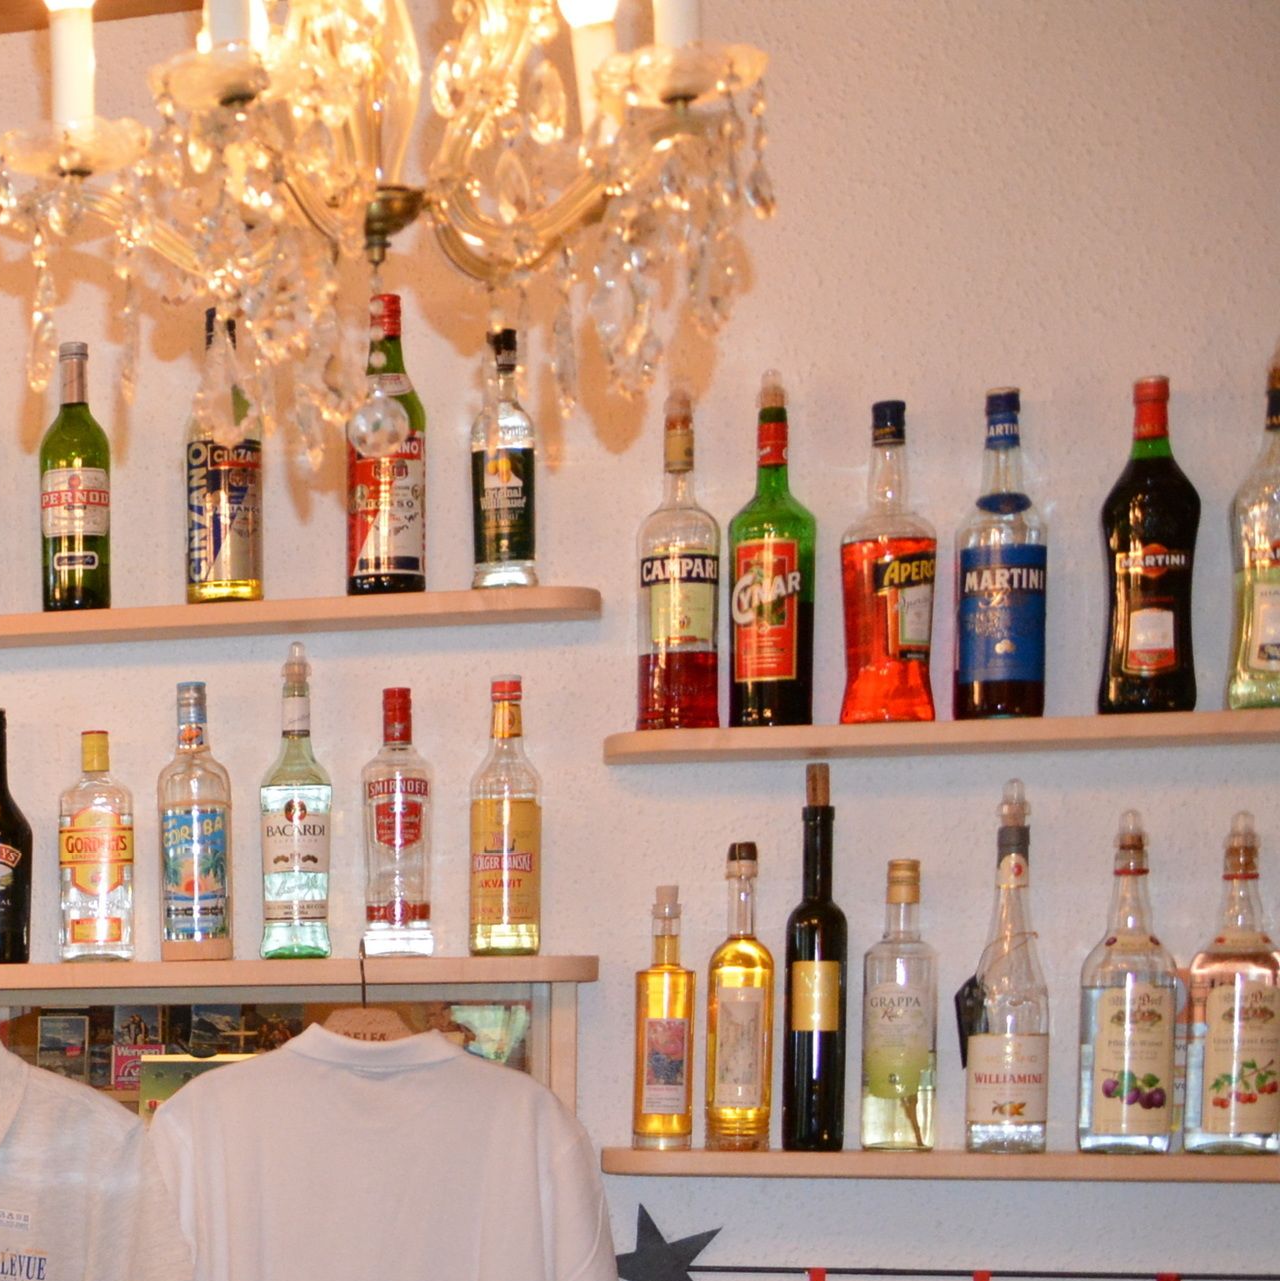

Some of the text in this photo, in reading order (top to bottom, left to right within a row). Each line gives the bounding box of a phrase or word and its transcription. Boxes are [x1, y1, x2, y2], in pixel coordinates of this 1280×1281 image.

[1121, 555, 1186, 568] MARTINI
[642, 557, 718, 583] CAMPARI
[964, 568, 1045, 593] MARTINI
[265, 825, 326, 838] BACARDI
[870, 996, 922, 1008] GRAPPA
